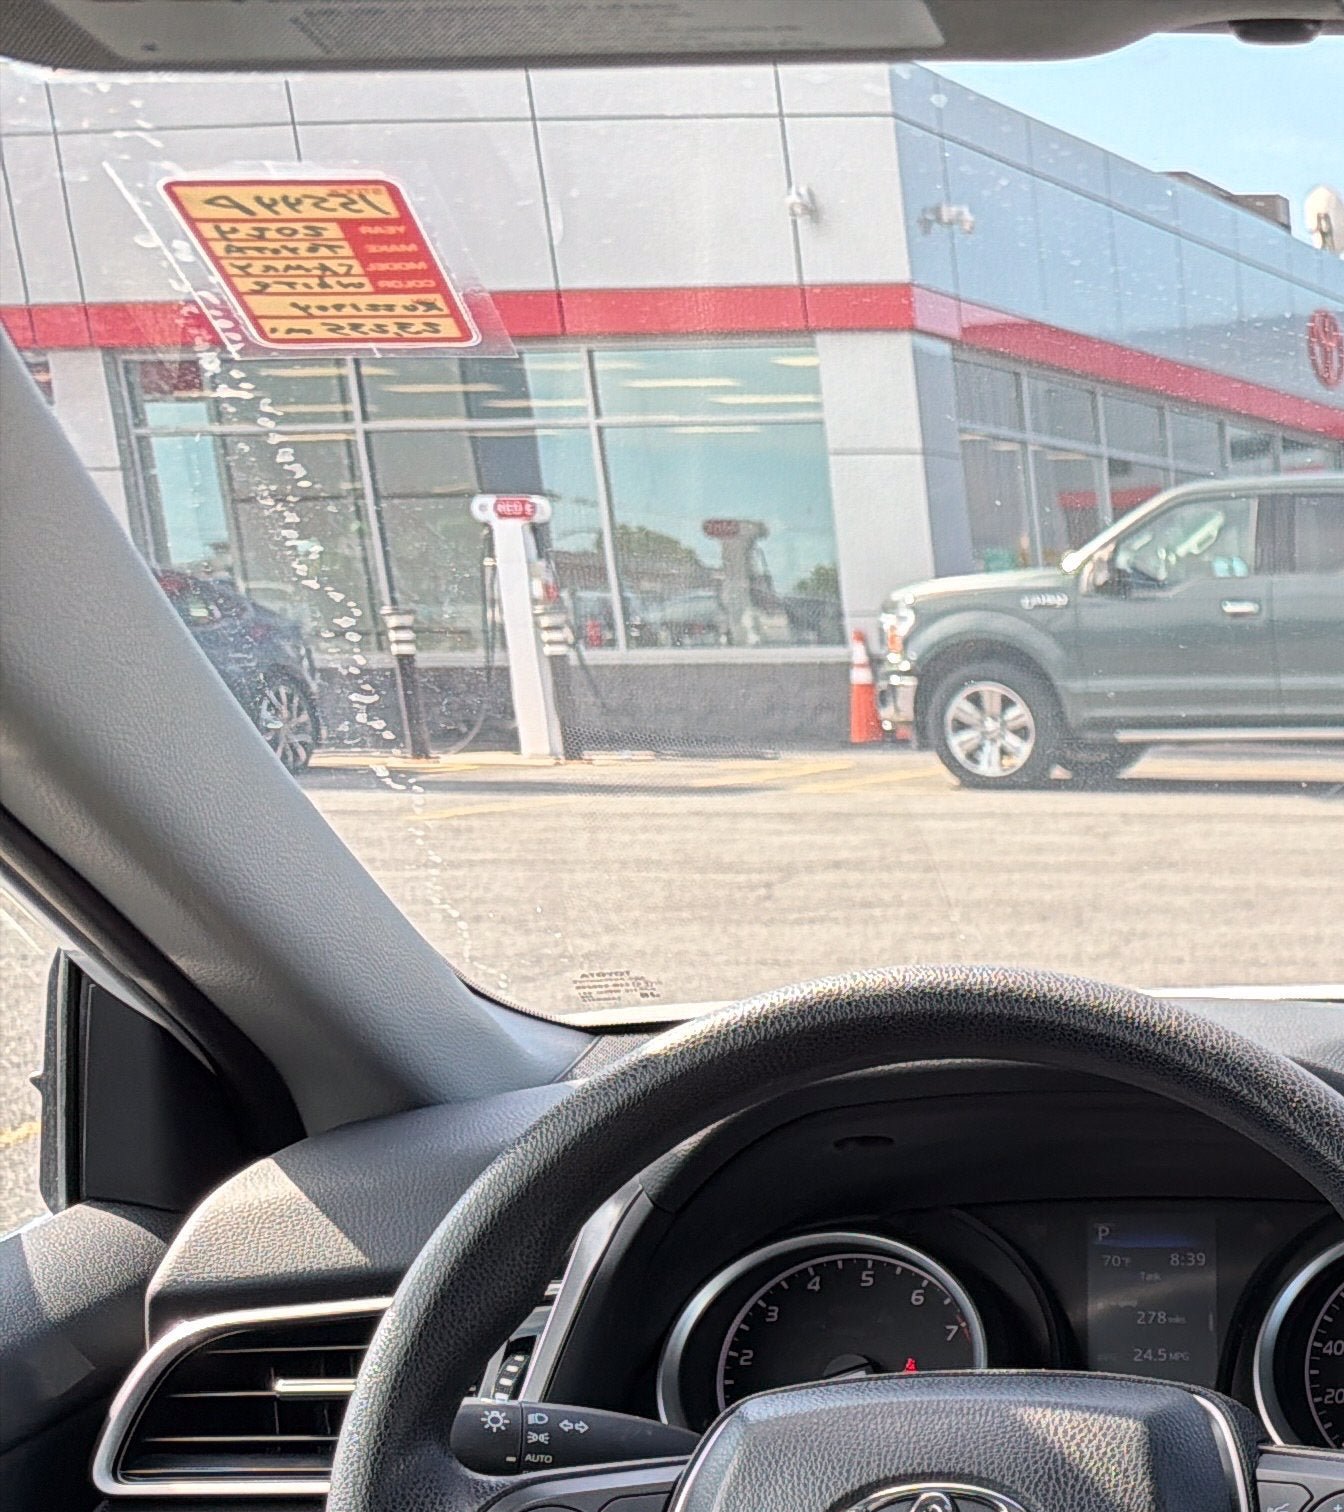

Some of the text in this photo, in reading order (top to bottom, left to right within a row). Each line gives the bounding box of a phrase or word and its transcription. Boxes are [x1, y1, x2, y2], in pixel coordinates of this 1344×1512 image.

[1098, 1225, 1110, 1241] P
[1169, 1251, 1206, 1267] 8:39
[806, 1275, 822, 1292] 4
[860, 1271, 875, 1287] 5
[910, 1288, 925, 1306] 6
[764, 1305, 779, 1323] 3
[1137, 1310, 1168, 1325] 278
[944, 1324, 959, 1341] 7
[1133, 1348, 1168, 1362] 24.5
[1169, 1352, 1191, 1361] MPG
[1322, 1339, 1344, 1356] 40
[739, 1349, 754, 1366] 2
[524, 1453, 553, 1464] AUTO
